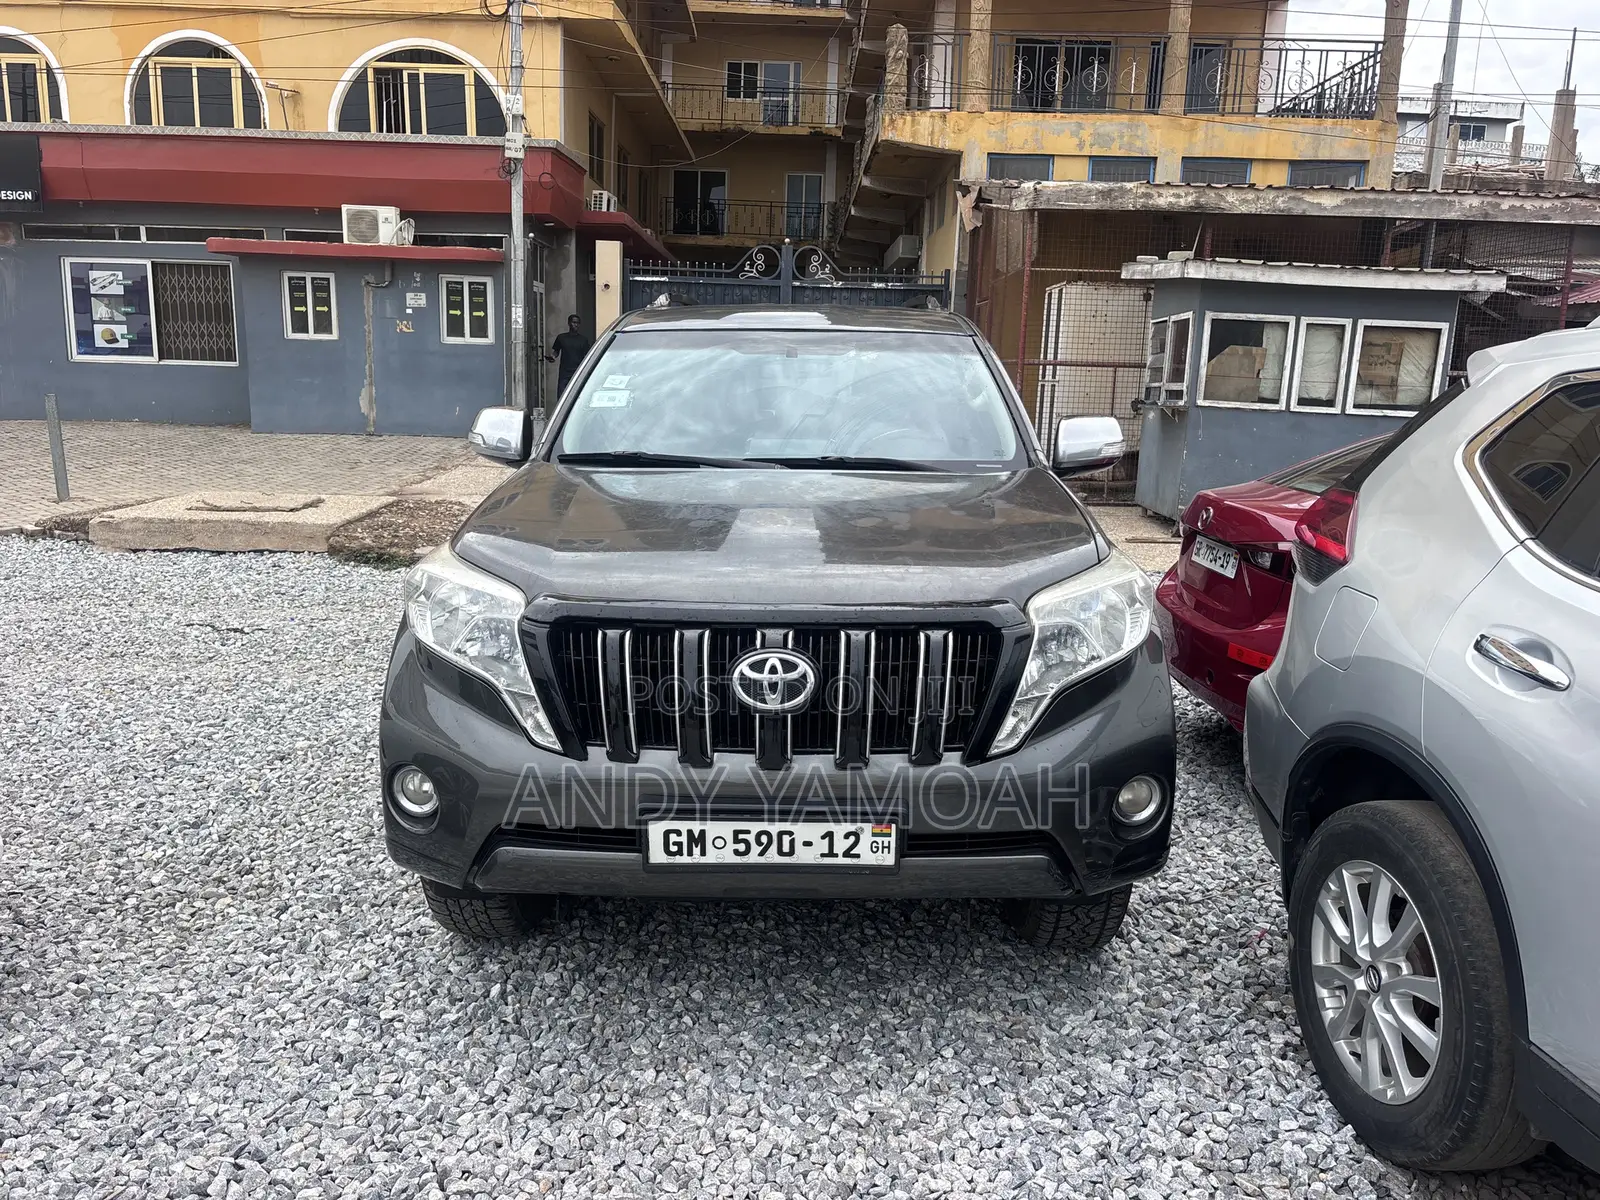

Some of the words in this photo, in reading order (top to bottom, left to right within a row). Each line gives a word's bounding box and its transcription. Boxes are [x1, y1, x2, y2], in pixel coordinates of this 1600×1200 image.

[0, 190, 33, 201] ESIGN
[662, 828, 707, 857] GM
[732, 829, 862, 859] 590-12
[869, 840, 891, 855] GH
